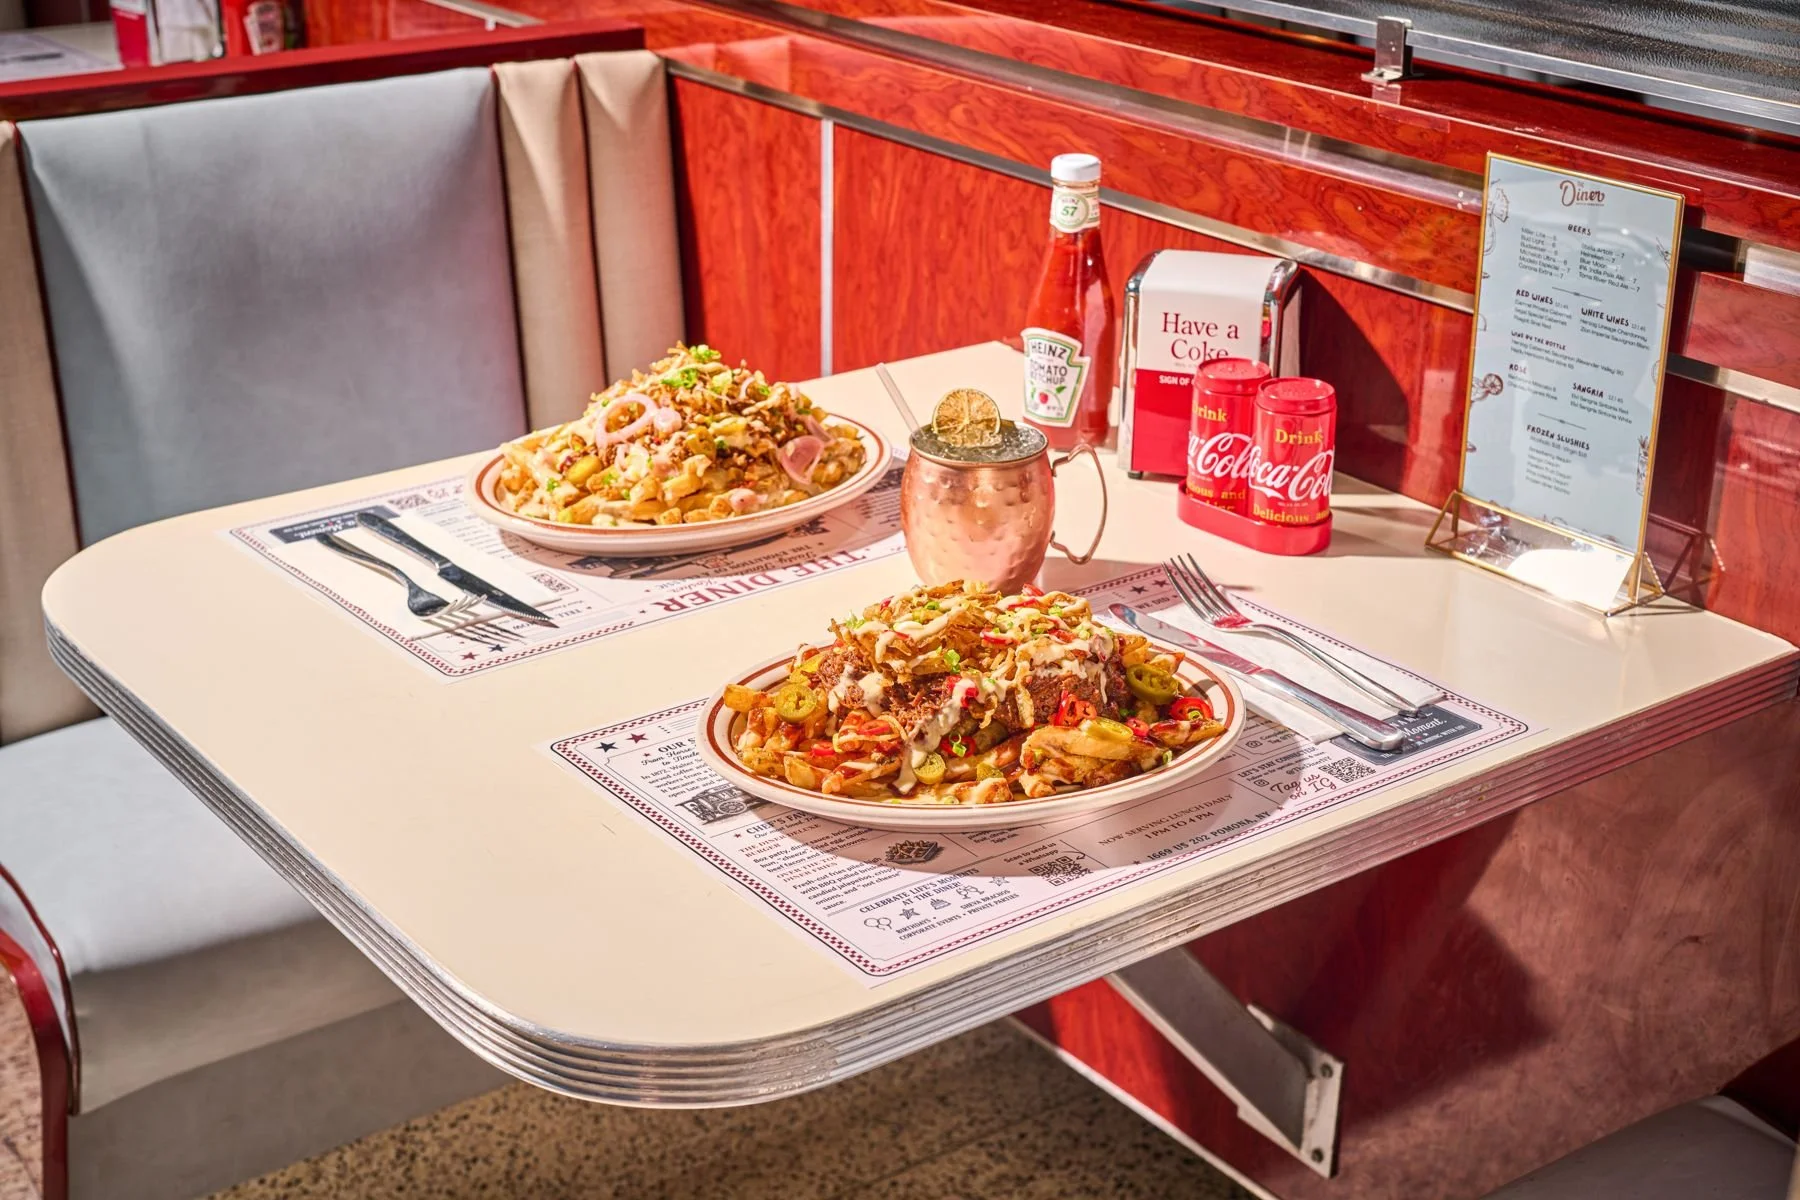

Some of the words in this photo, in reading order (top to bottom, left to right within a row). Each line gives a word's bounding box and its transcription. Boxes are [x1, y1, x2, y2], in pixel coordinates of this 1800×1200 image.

[1560, 180, 1605, 207] Diner
[1061, 206, 1078, 216] 57
[1567, 224, 1591, 236] BEERS
[1515, 289, 1530, 297] RED
[1531, 293, 1553, 305] WINES
[1162, 312, 1218, 337] Have
[1227, 324, 1239, 339] a
[1581, 307, 1604, 319] WHITE
[1606, 314, 1629, 326] WINES
[1030, 342, 1067, 359] HEINZ
[1545, 340, 1566, 350] BOTTLE
[1029, 359, 1067, 376] TOMATO
[1159, 374, 1178, 384] SIGN
[1179, 377, 1190, 386] OF
[1573, 383, 1603, 398] SANGRIA
[1275, 428, 1325, 444] Drink
[1526, 424, 1555, 439] FROZEN
[1557, 434, 1589, 450] SLUSHIES
[1253, 504, 1309, 523] Delicious
[788, 549, 867, 577] THE
[653, 573, 782, 614] DINER
[658, 741, 686, 753] OUR
[672, 767, 694, 776] coffee
[1237, 767, 1259, 778] LET'S
[1257, 760, 1276, 770] STAY
[654, 777, 683, 788] workers
[683, 771, 702, 779] from
[667, 780, 695, 791] became
[1269, 781, 1302, 793] Tag
[1303, 774, 1320, 783] us
[1289, 788, 1307, 800] on
[1308, 777, 1337, 792] IG
[668, 790, 686, 798] open
[746, 818, 785, 834] CHEF'S
[1098, 833, 1124, 845] NOW
[1125, 817, 1169, 836] SERVING
[1168, 804, 1204, 820] LUNCH
[1203, 794, 1232, 807] DAILY
[1151, 827, 1171, 836] PM
[1167, 820, 1187, 829] TO
[1194, 811, 1214, 820] PM
[738, 845, 756, 853] THE
[758, 835, 786, 846] DINER
[786, 824, 820, 837] DELUXE
[1147, 848, 1172, 860] 1669
[1172, 842, 1189, 850] US
[1188, 834, 1211, 845] 202
[1210, 819, 1257, 836] POMONA,
[1255, 810, 1270, 820] NY
[745, 843, 780, 857] BURGER
[768, 849, 790, 859] patty,
[790, 842, 810, 851] diner
[809, 835, 833, 844] sauce,
[810, 842, 829, 850] fried
[1003, 854, 1023, 863] Scan
[1030, 844, 1048, 854] send
[766, 864, 784, 873] beef
[783, 858, 806, 867] facon
[806, 852, 820, 860] and
[820, 846, 838, 854] hash
[776, 868, 801, 878] OVER
[802, 861, 820, 870] THE
[819, 854, 838, 863] TOP
[783, 870, 811, 883] DINER
[811, 862, 837, 872] FRIES
[792, 874, 829, 889] Fresh-cut
[846, 862, 865, 872] piled
[800, 886, 819, 895] with
[817, 879, 837, 888] BBQ
[836, 870, 859, 882] pulled
[808, 886, 837, 900] candied
[874, 866, 896, 876] crispy
[859, 892, 909, 913] CELEBRATE
[909, 882, 937, 894] LIFE'S
[937, 868, 979, 884] MOMENTS
[815, 893, 843, 905] onions,
[843, 886, 858, 895] and
[902, 898, 914, 906] AT
[913, 891, 934, 900] THE
[932, 881, 961, 894] DINER!
[960, 900, 982, 909] SHEVA
[980, 889, 1010, 902] BRACHOS
[822, 900, 846, 910] sauce.
[895, 918, 931, 934] BIRTHDAYS
[899, 923, 937, 940] CORPORATE
[936, 914, 961, 926] EVENTS
[967, 902, 994, 914] PRIVATE
[993, 893, 1019, 905] PARTIES
